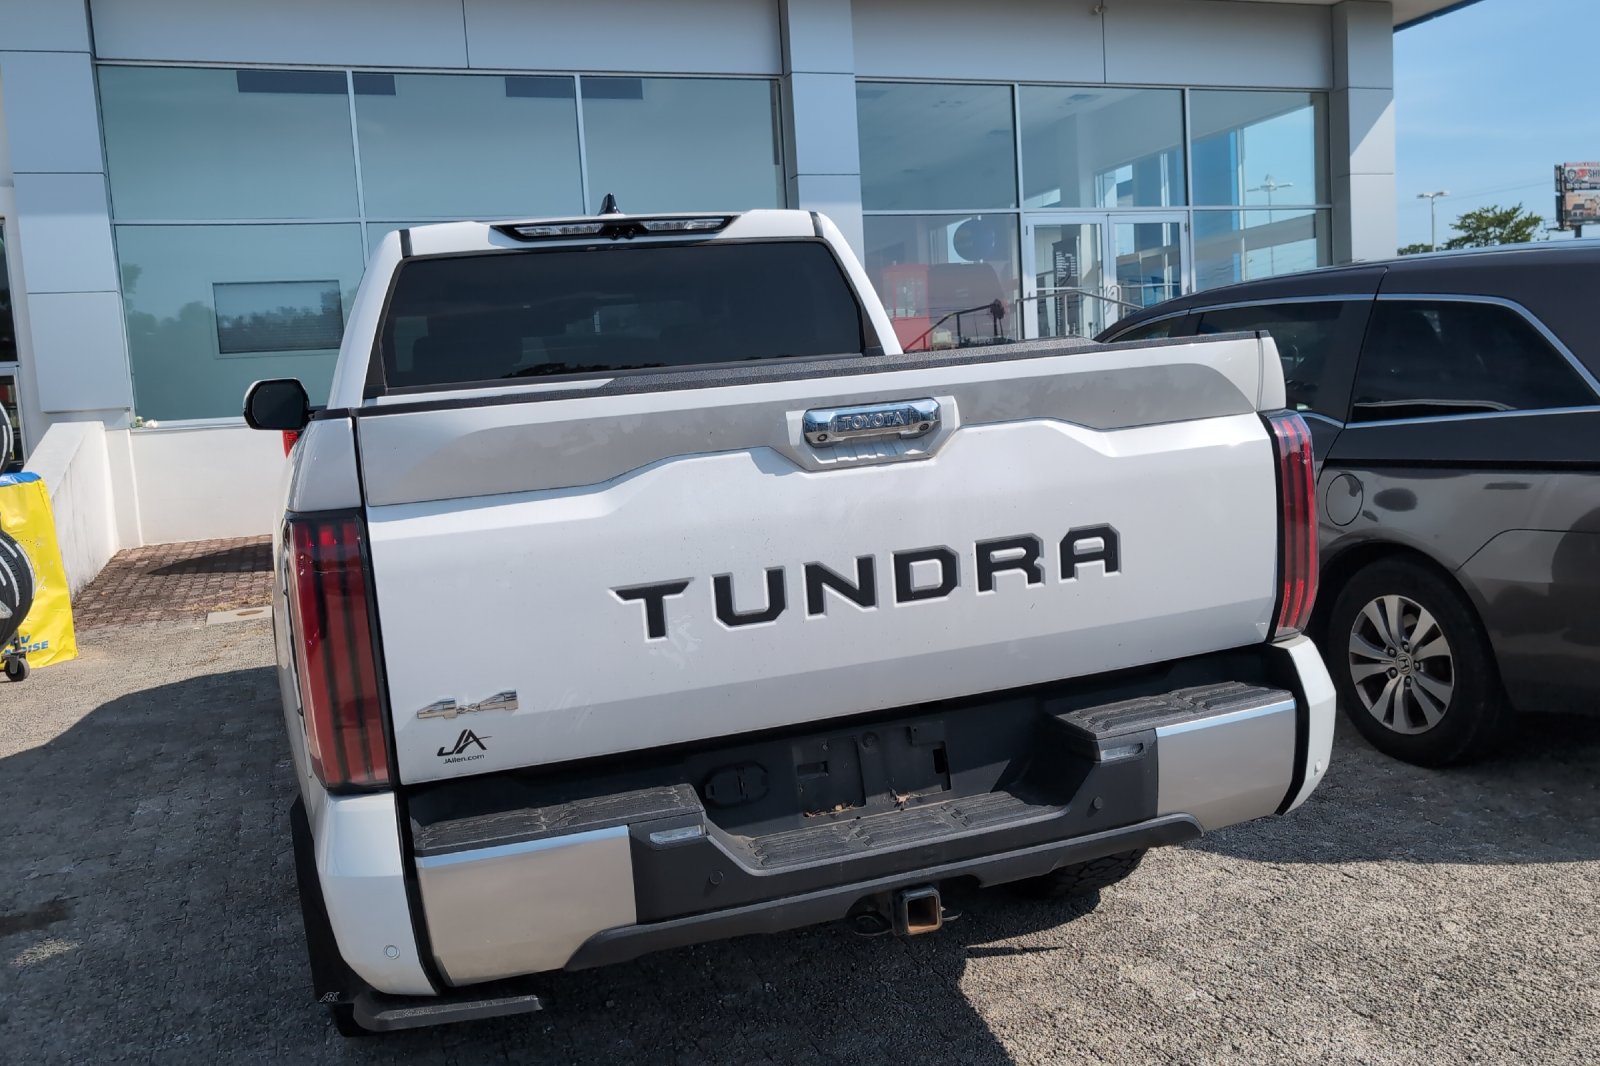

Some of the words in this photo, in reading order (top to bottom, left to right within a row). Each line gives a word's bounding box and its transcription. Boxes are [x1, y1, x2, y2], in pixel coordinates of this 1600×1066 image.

[842, 411, 905, 430] TOYOTA
[608, 523, 1122, 642] TUNDRA
[443, 754, 485, 764] JAllen.com
